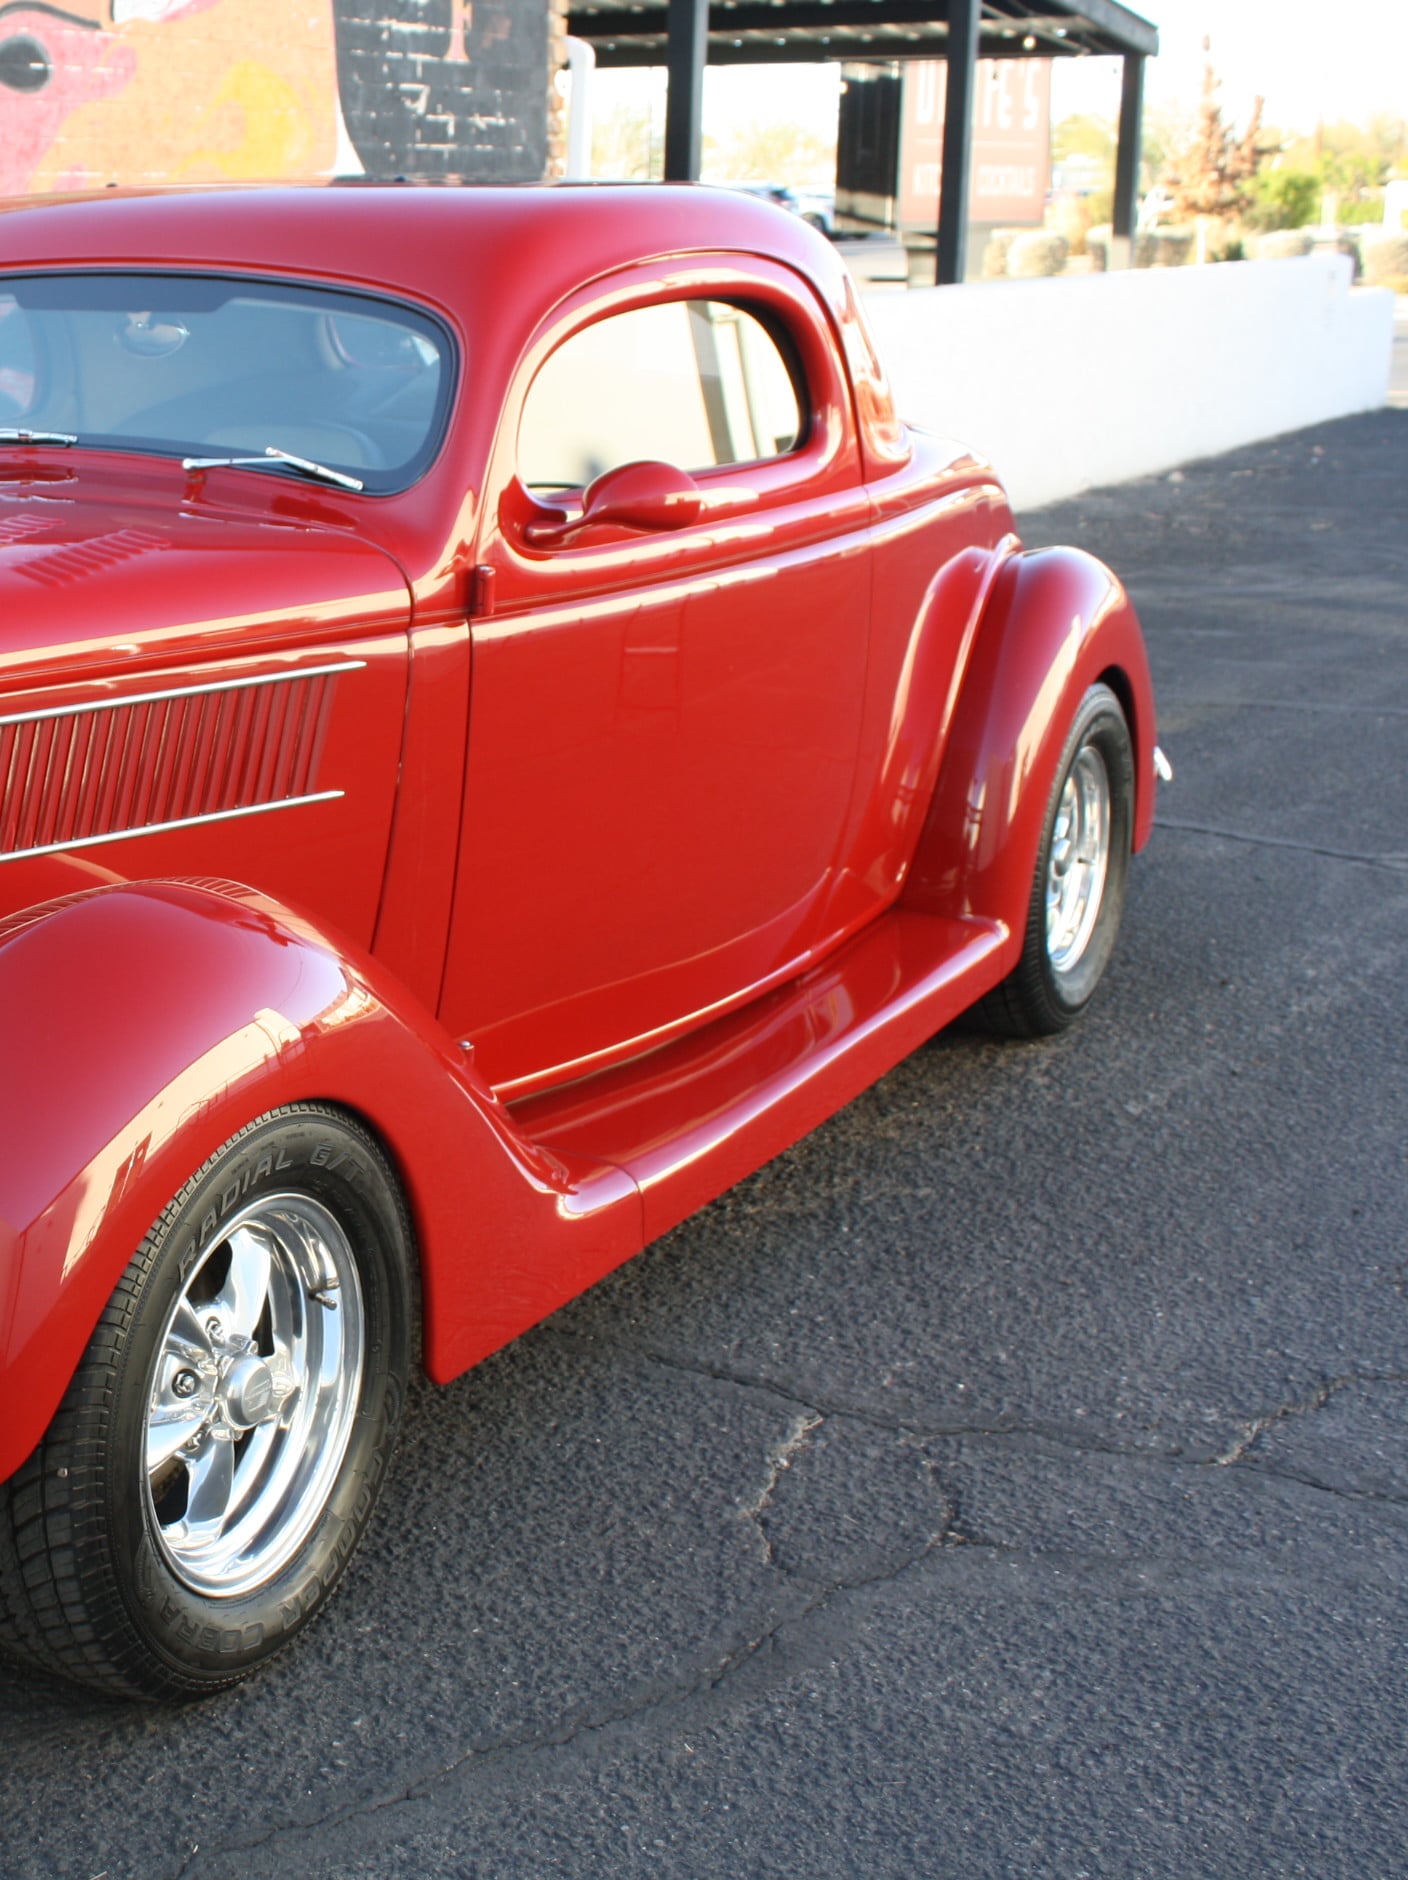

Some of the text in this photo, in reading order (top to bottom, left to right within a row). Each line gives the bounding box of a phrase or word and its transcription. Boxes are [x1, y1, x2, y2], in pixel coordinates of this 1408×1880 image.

[178, 1147, 294, 1284] RADIAL
[309, 1141, 367, 1184] G/T
[158, 1450, 384, 1654] COOPER COBRA
